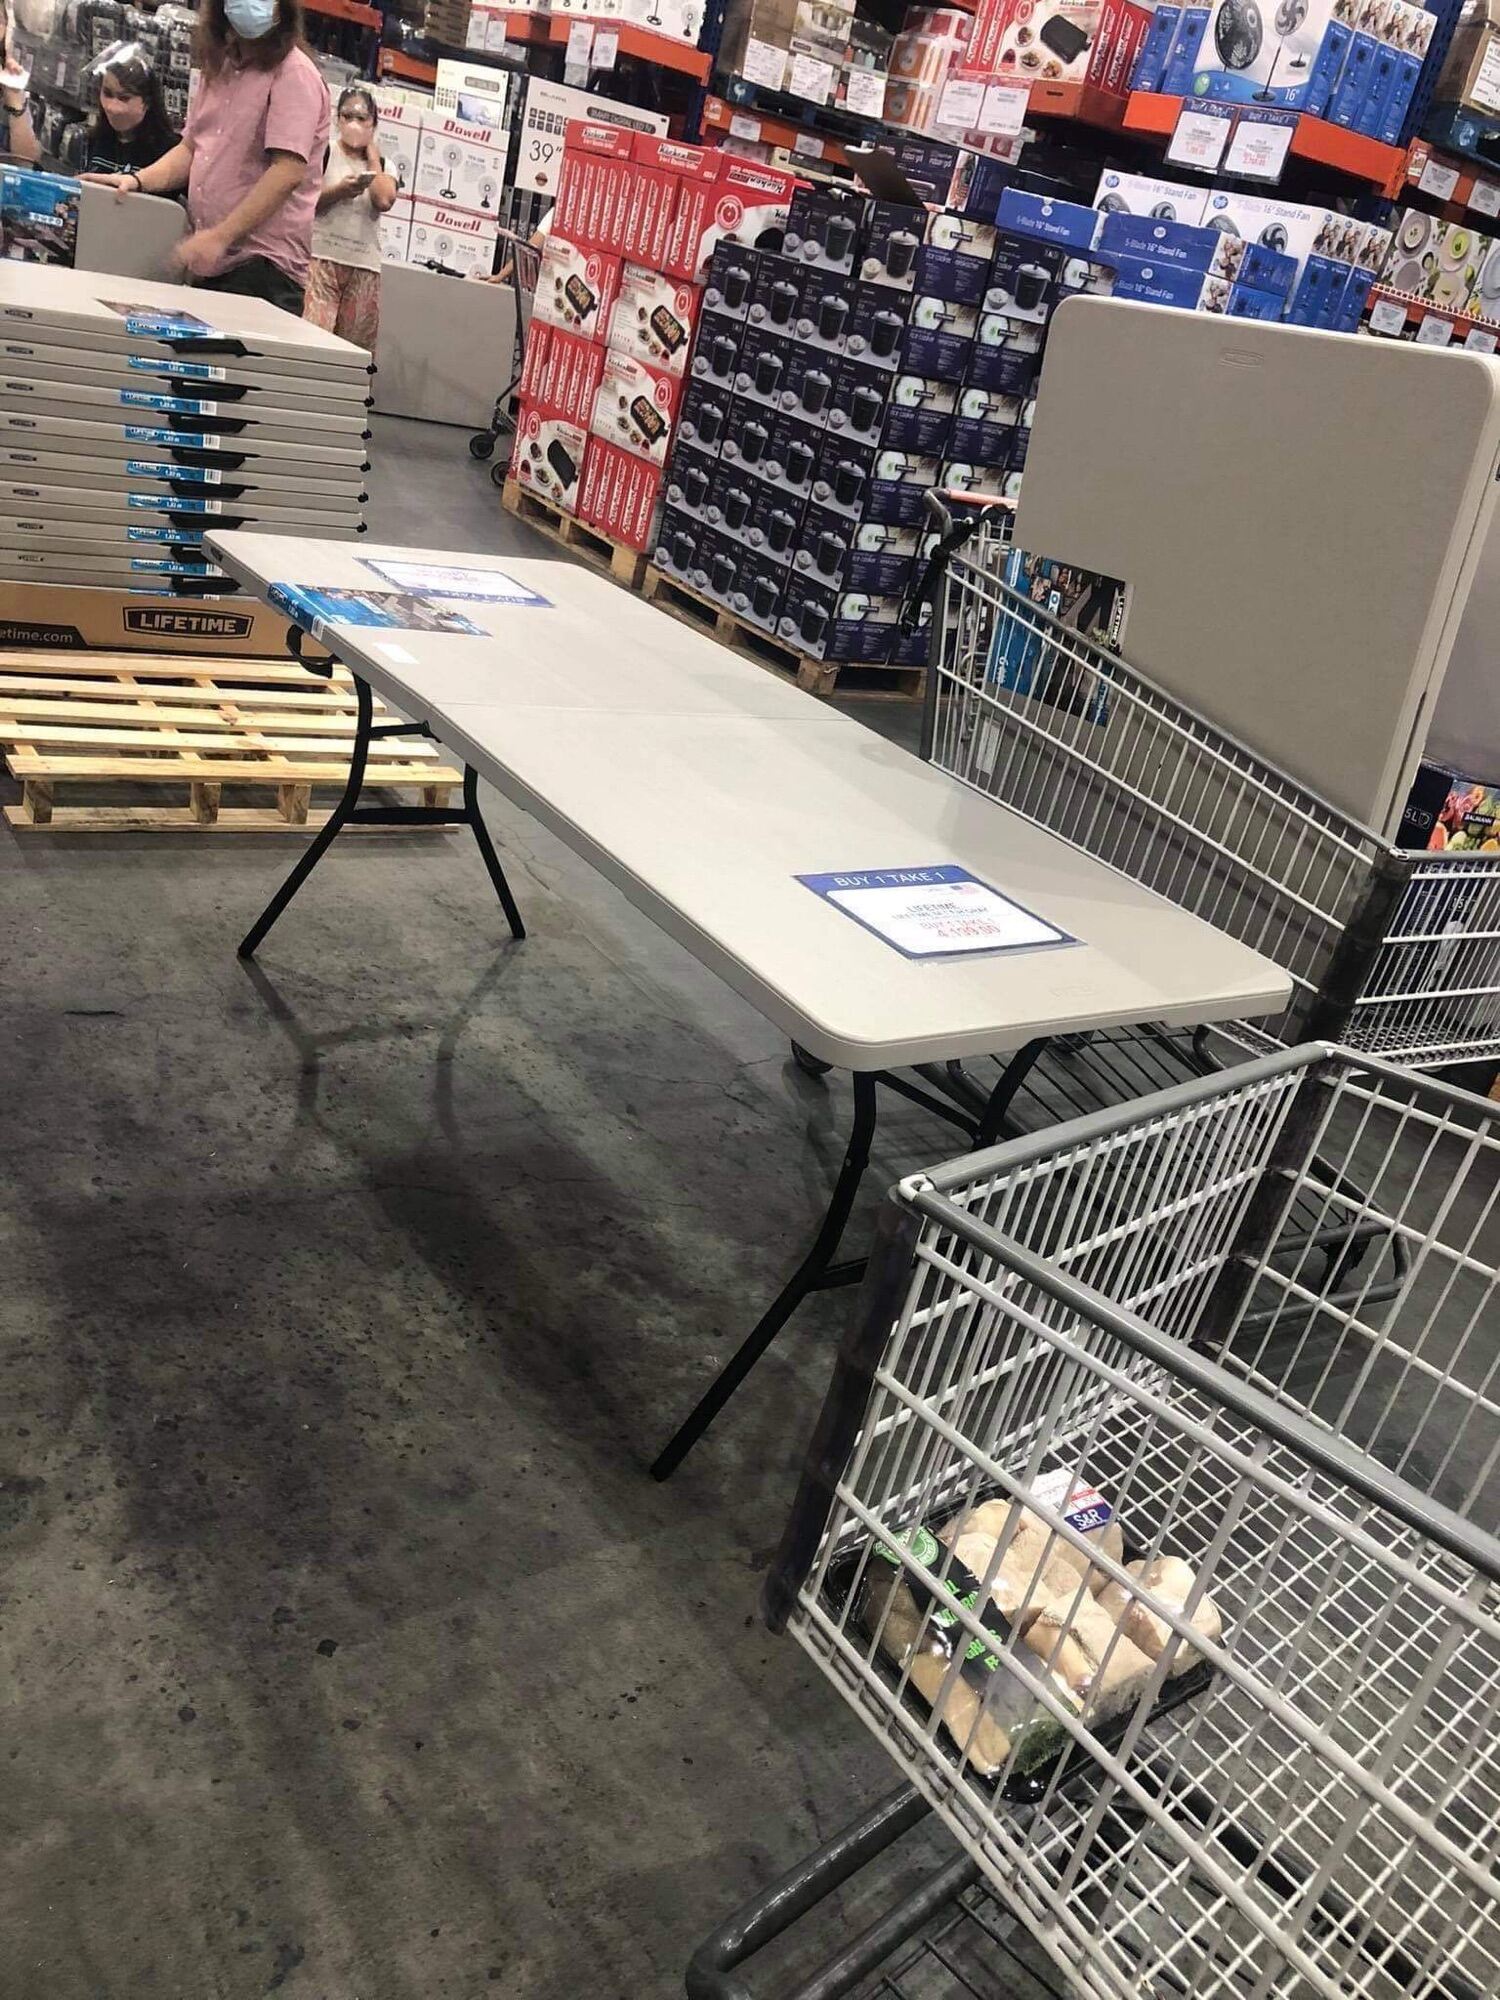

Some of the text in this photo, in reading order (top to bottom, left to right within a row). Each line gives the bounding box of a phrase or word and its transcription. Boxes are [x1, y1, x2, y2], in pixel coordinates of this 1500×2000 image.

[443, 119, 492, 143] Dowell
[434, 211, 482, 232] Dowell
[140, 613, 237, 633] LIFETIME
[834, 871, 945, 886] BUY 1 TAKE 1
[1073, 1508, 1103, 1528] S&R
